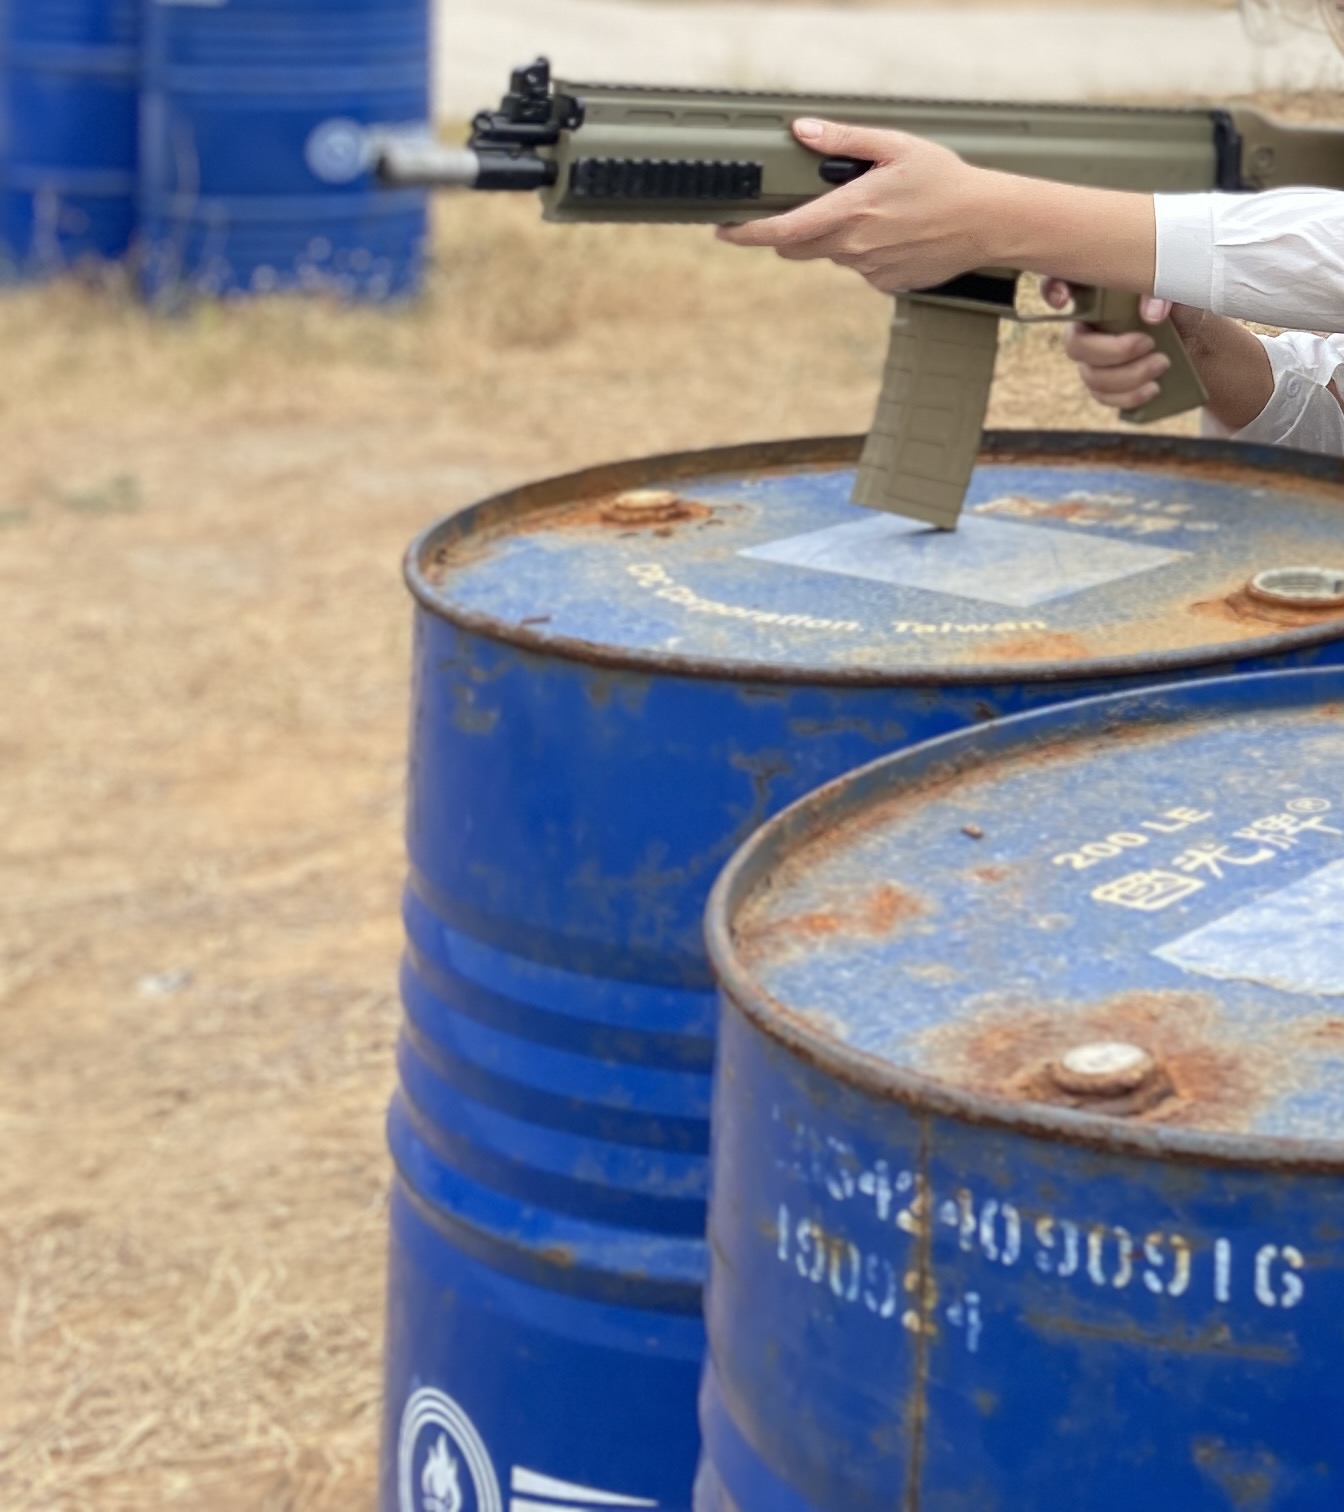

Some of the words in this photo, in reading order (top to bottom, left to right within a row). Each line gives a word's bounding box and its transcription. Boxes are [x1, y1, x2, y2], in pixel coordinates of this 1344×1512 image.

[891, 620, 1047, 634] Taiwan
[1051, 831, 1149, 870] 200
[1140, 805, 1214, 833] LE
